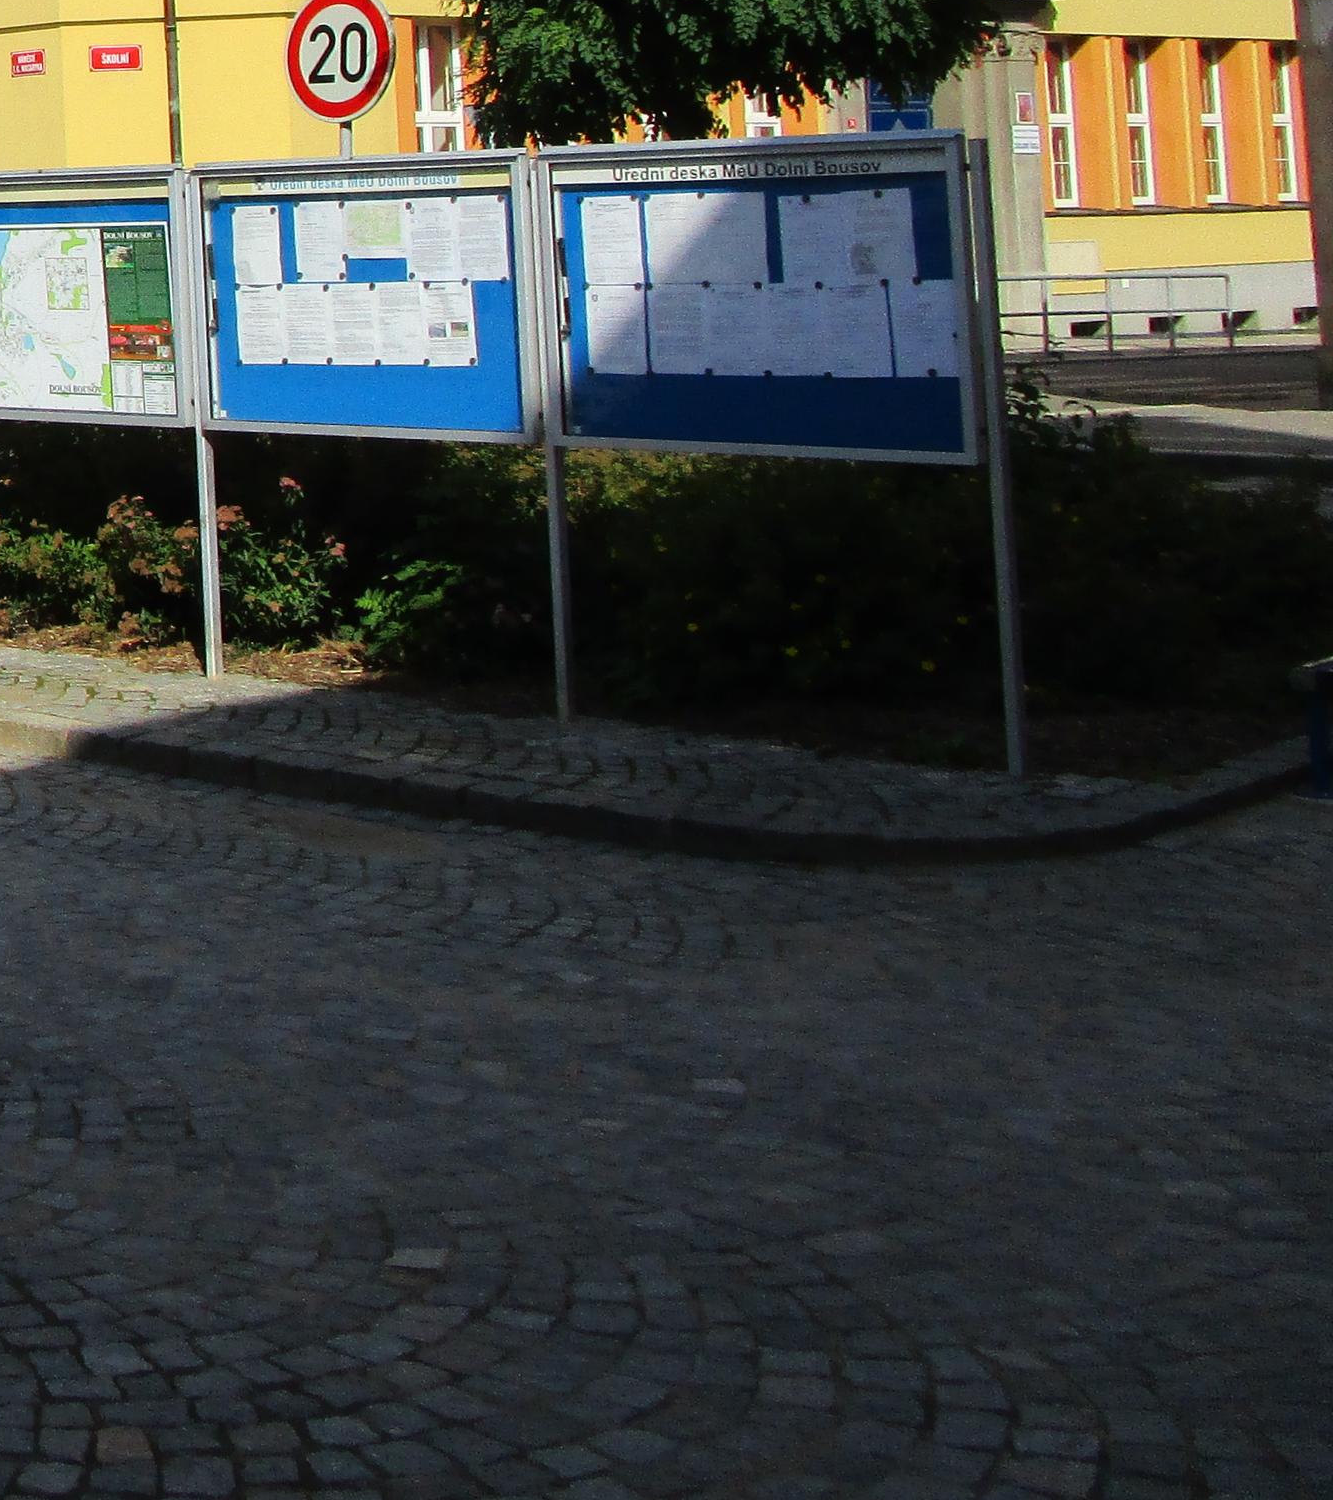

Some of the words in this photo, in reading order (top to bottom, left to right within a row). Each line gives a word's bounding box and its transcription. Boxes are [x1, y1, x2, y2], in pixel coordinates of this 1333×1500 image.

[100, 52, 130, 65] ŠKOLNÍ
[308, 22, 368, 84] 20
[670, 164, 718, 180] deska
[814, 161, 881, 175] Bousov
